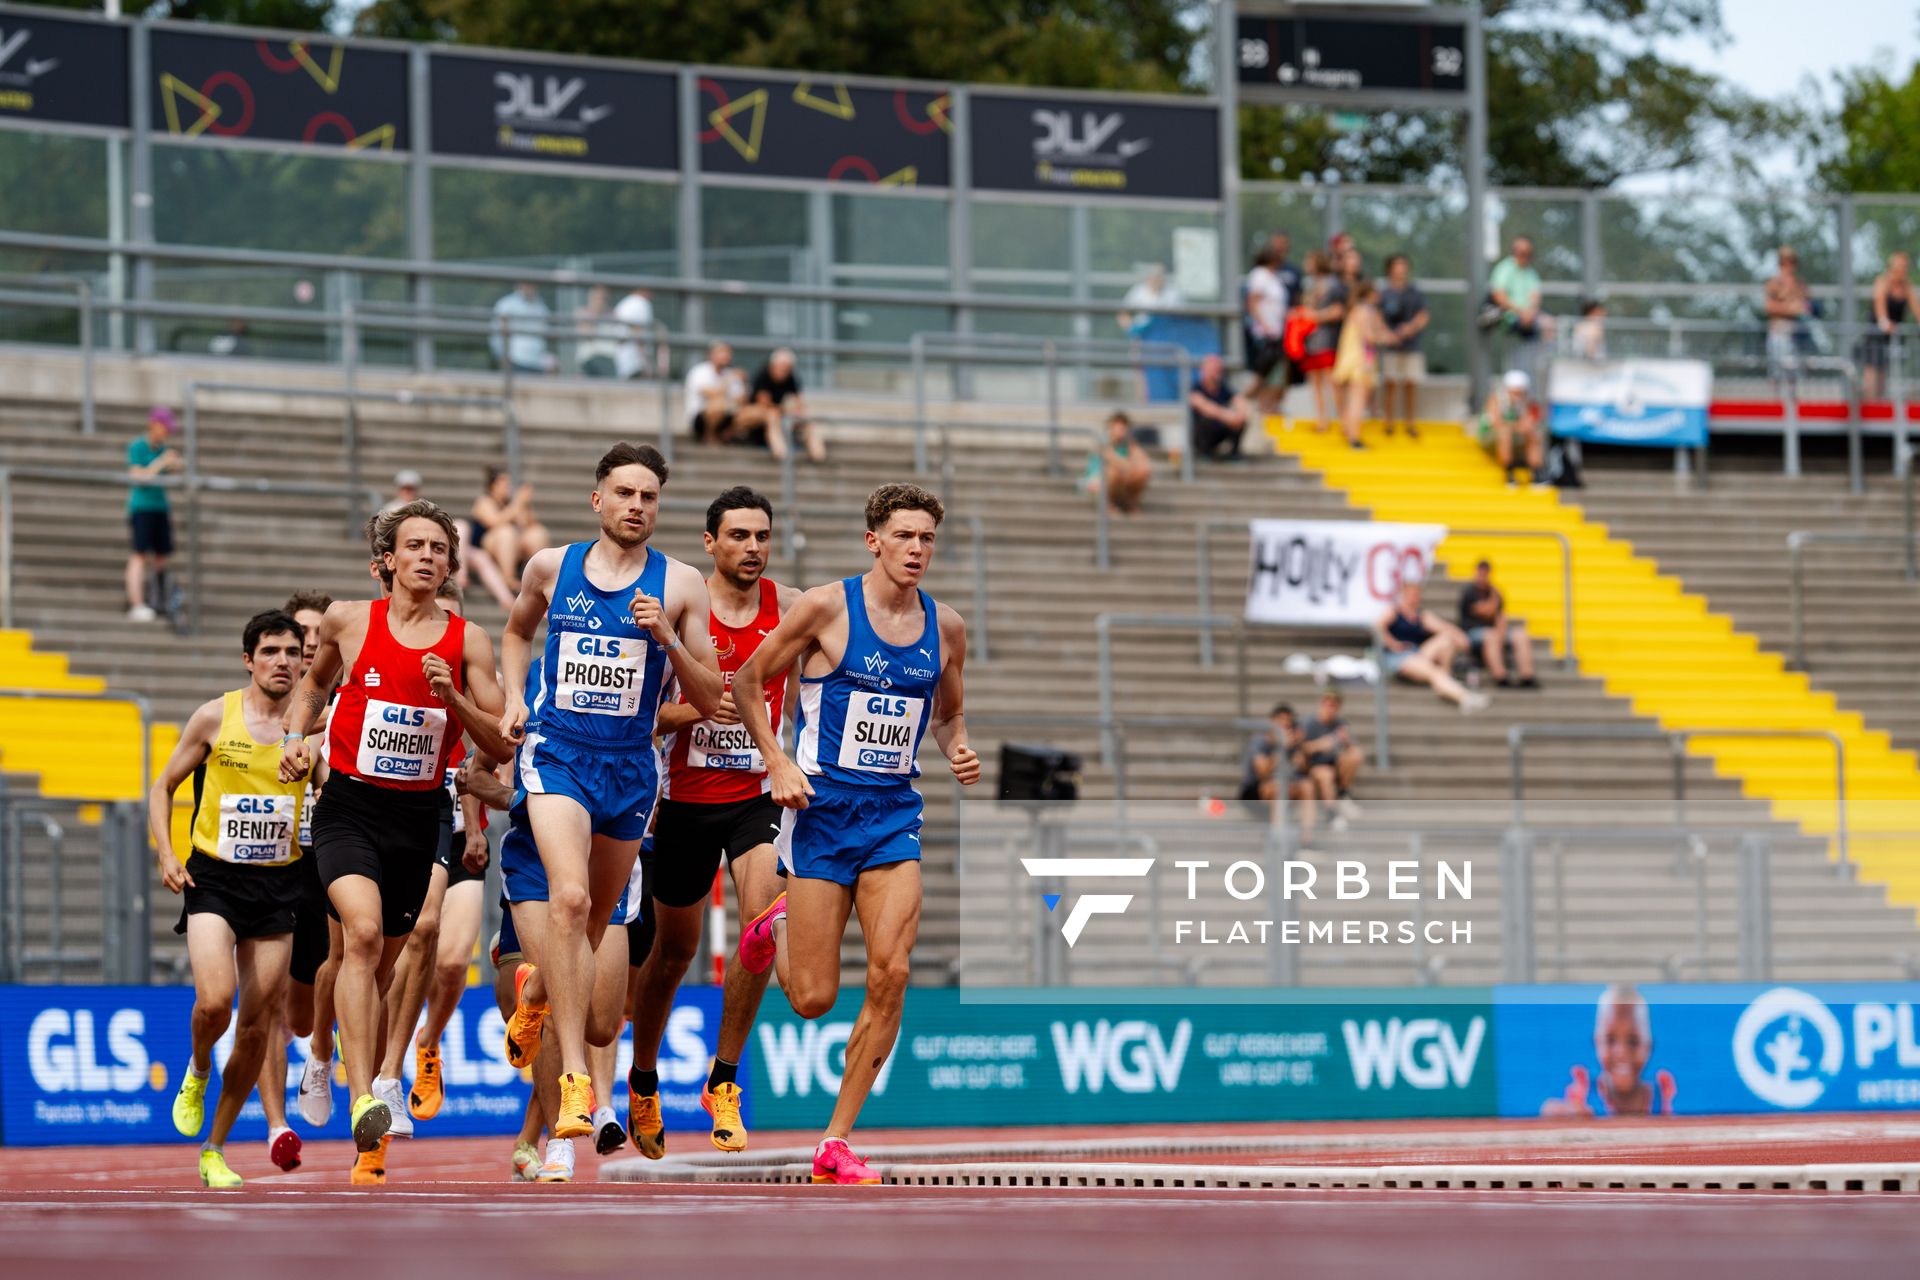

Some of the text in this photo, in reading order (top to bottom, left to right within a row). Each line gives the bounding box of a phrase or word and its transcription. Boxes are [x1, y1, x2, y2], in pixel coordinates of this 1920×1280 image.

[551, 613, 586, 622] STADTWERKE
[564, 661, 637, 689] PROBST
[845, 670, 880, 682] STADTWERKE
[903, 666, 935, 679] VIACTIV
[591, 694, 619, 705] PLAN
[627, 697, 636, 709] 772
[854, 720, 911, 747] SLUKA
[367, 727, 435, 755] SCHREML
[725, 757, 750, 766] PLAN
[877, 753, 900, 763] PLAN
[395, 761, 420, 771] PLAN
[227, 819, 288, 841] BENITZ
[252, 847, 275, 855] PLAN
[1050, 1018, 1193, 1094] WGV
[1341, 1016, 1487, 1090] WGV
